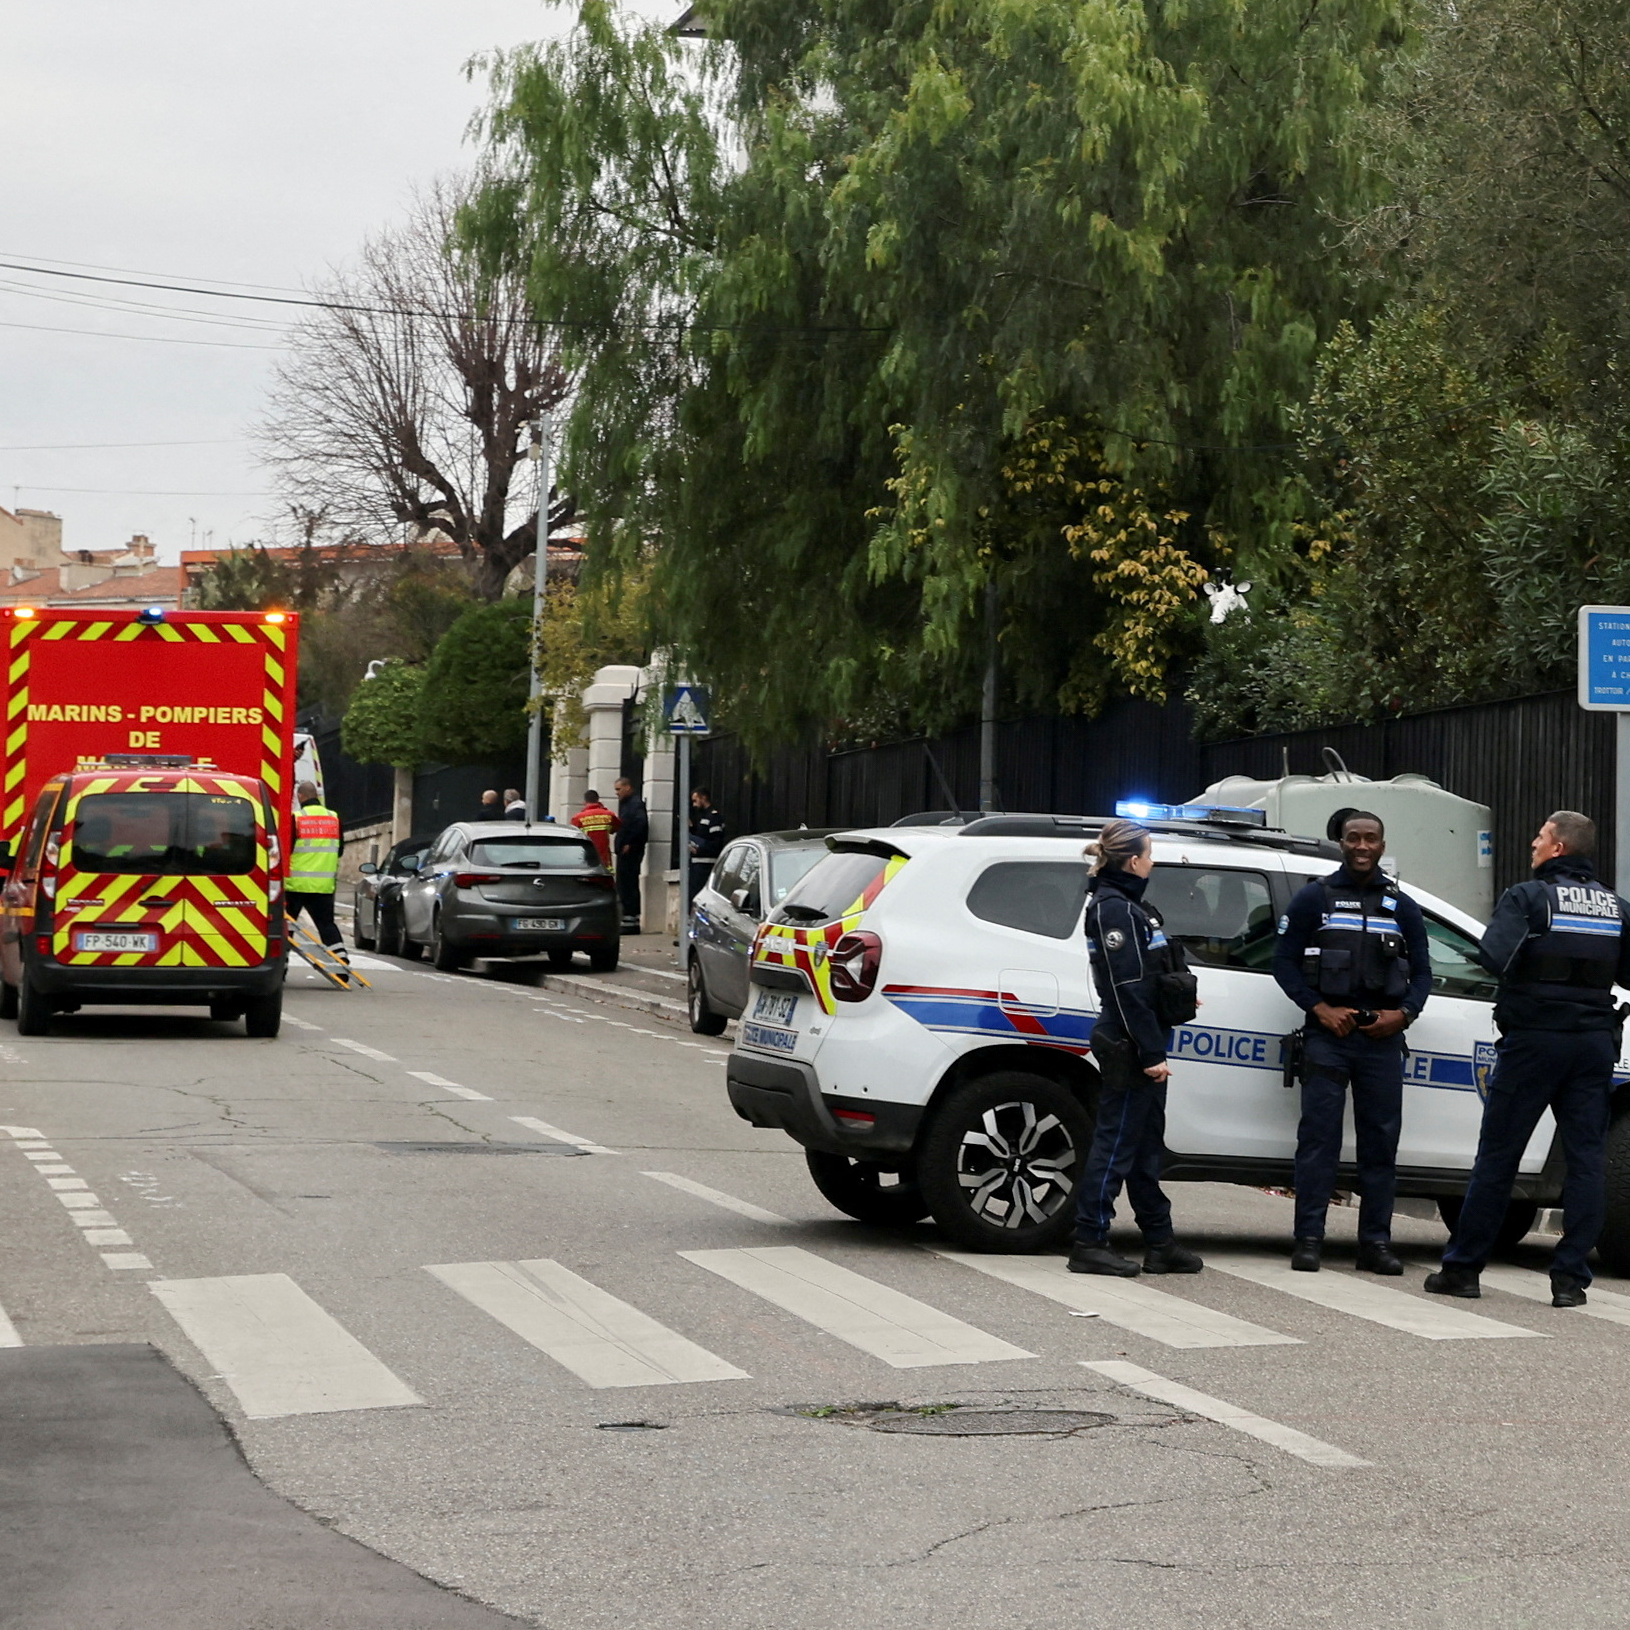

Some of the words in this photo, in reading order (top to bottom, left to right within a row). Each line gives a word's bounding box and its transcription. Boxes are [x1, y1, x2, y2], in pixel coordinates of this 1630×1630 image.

[1602, 654, 1614, 663] EN
[27, 704, 122, 722] MARINS
[140, 705, 263, 725] POMPIERS
[128, 730, 161, 748] DE
[1335, 900, 1362, 909] POLICE
[1556, 886, 1618, 908] POLICE
[1559, 901, 1620, 919] MUNICIPALE
[1177, 1030, 1266, 1062] POLICE
